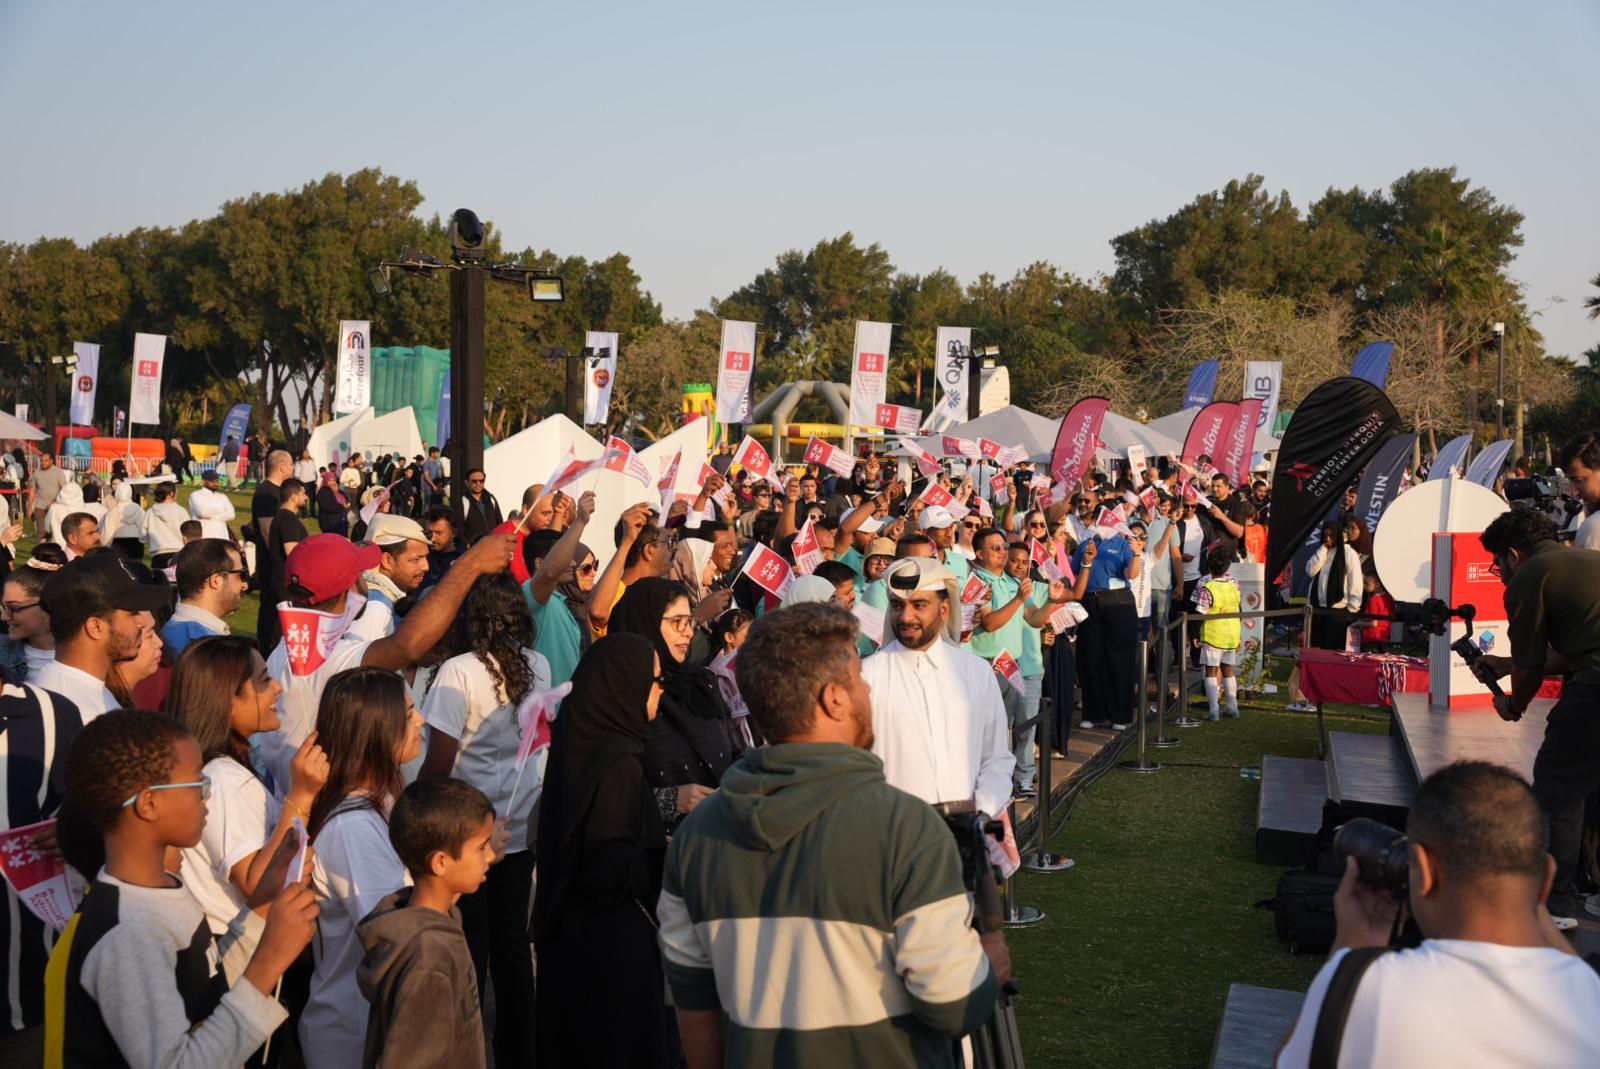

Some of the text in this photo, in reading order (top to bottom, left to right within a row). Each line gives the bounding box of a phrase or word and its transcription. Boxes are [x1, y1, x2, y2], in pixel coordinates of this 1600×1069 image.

[354, 355, 365, 406] Carrefour
[1067, 414, 1092, 471] ortons
[1226, 412, 1250, 466] Hortons
[1306, 451, 1344, 492] MARRIOTT
[1343, 413, 1381, 450] MARQUIS
[1314, 477, 1333, 498] CITY
[1333, 445, 1361, 477] CENTER
[1361, 420, 1385, 446] DOHA
[1365, 474, 1390, 533] WESTIN
